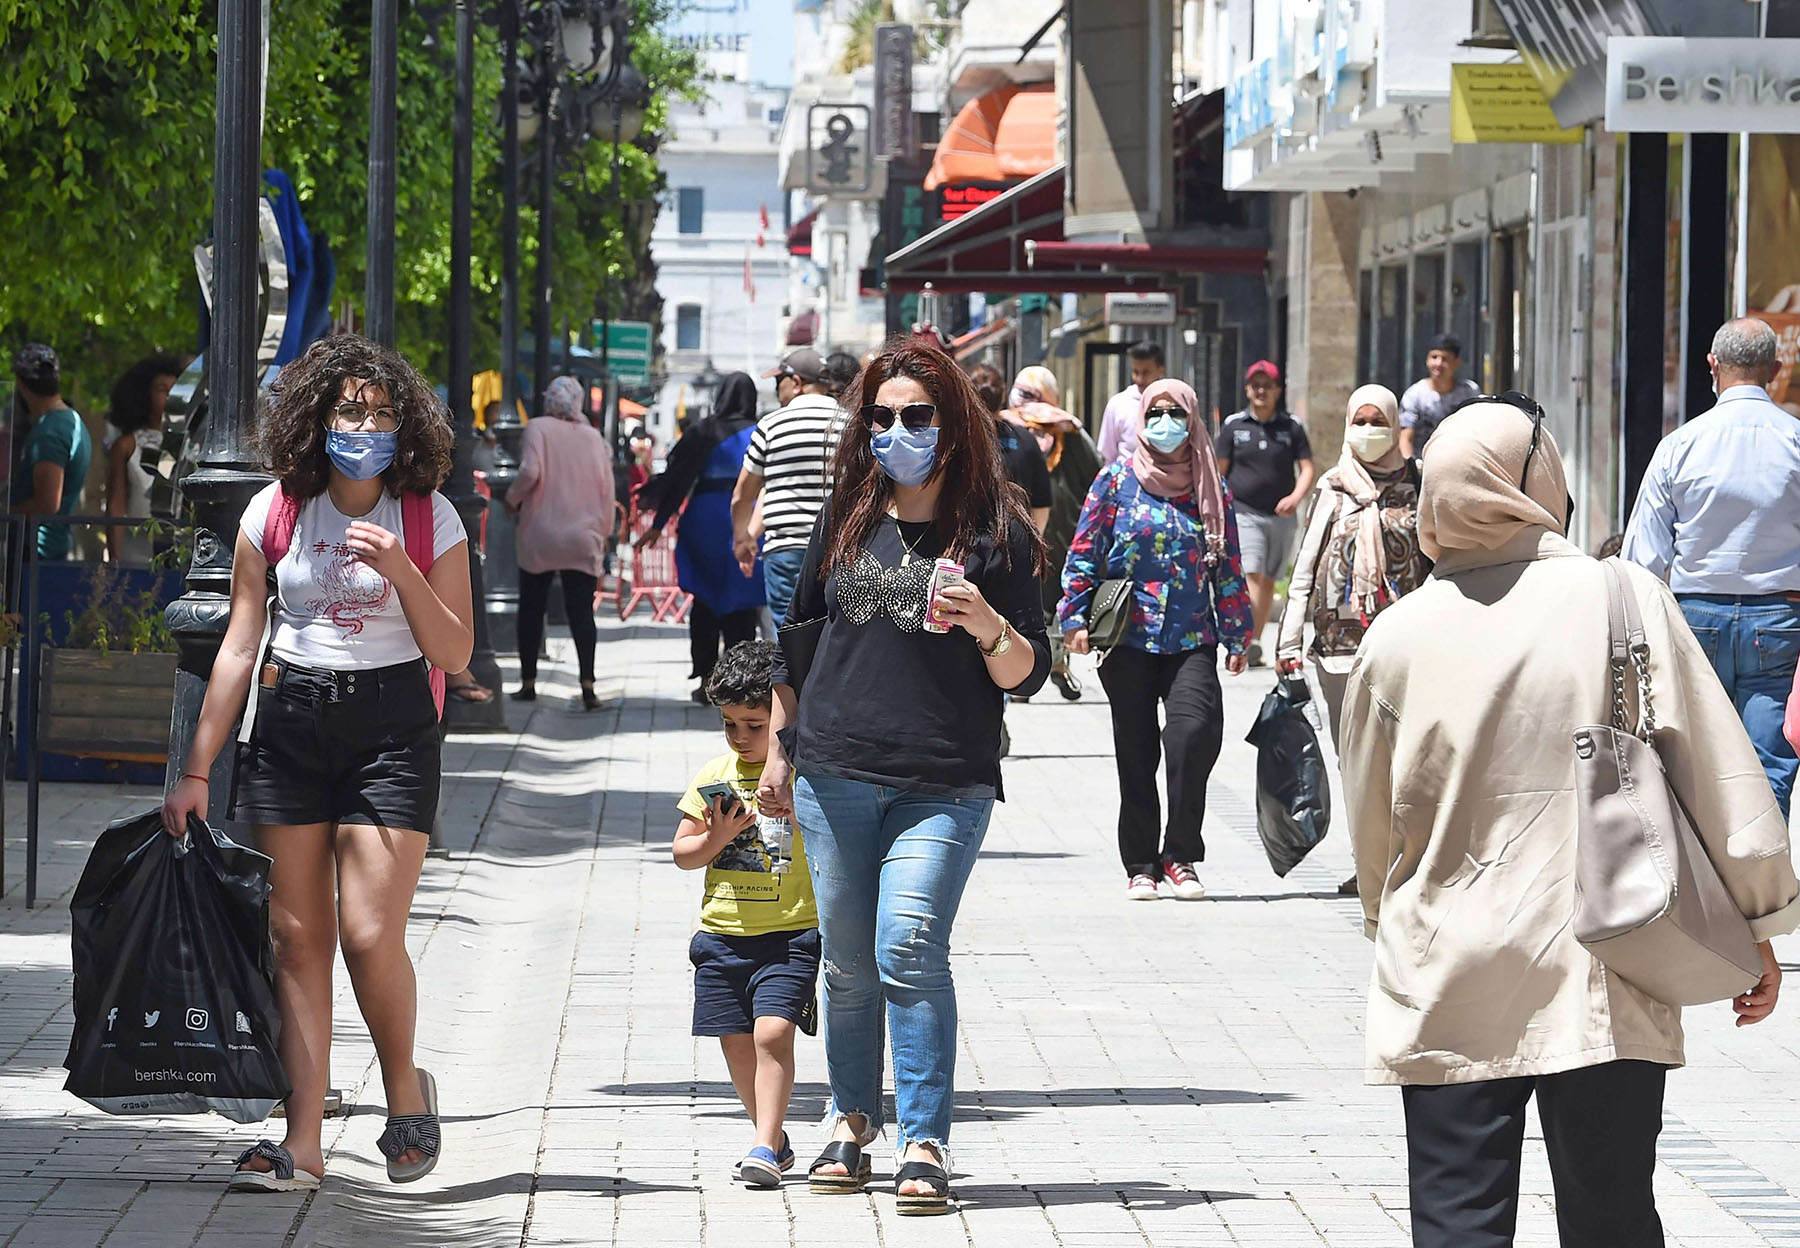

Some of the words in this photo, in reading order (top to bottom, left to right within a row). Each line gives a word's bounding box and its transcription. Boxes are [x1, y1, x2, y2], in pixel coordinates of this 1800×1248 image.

[1623, 57, 1800, 104] Bershka
[313, 539, 350, 557] 幸福
[134, 1069, 217, 1083] bershka.com
